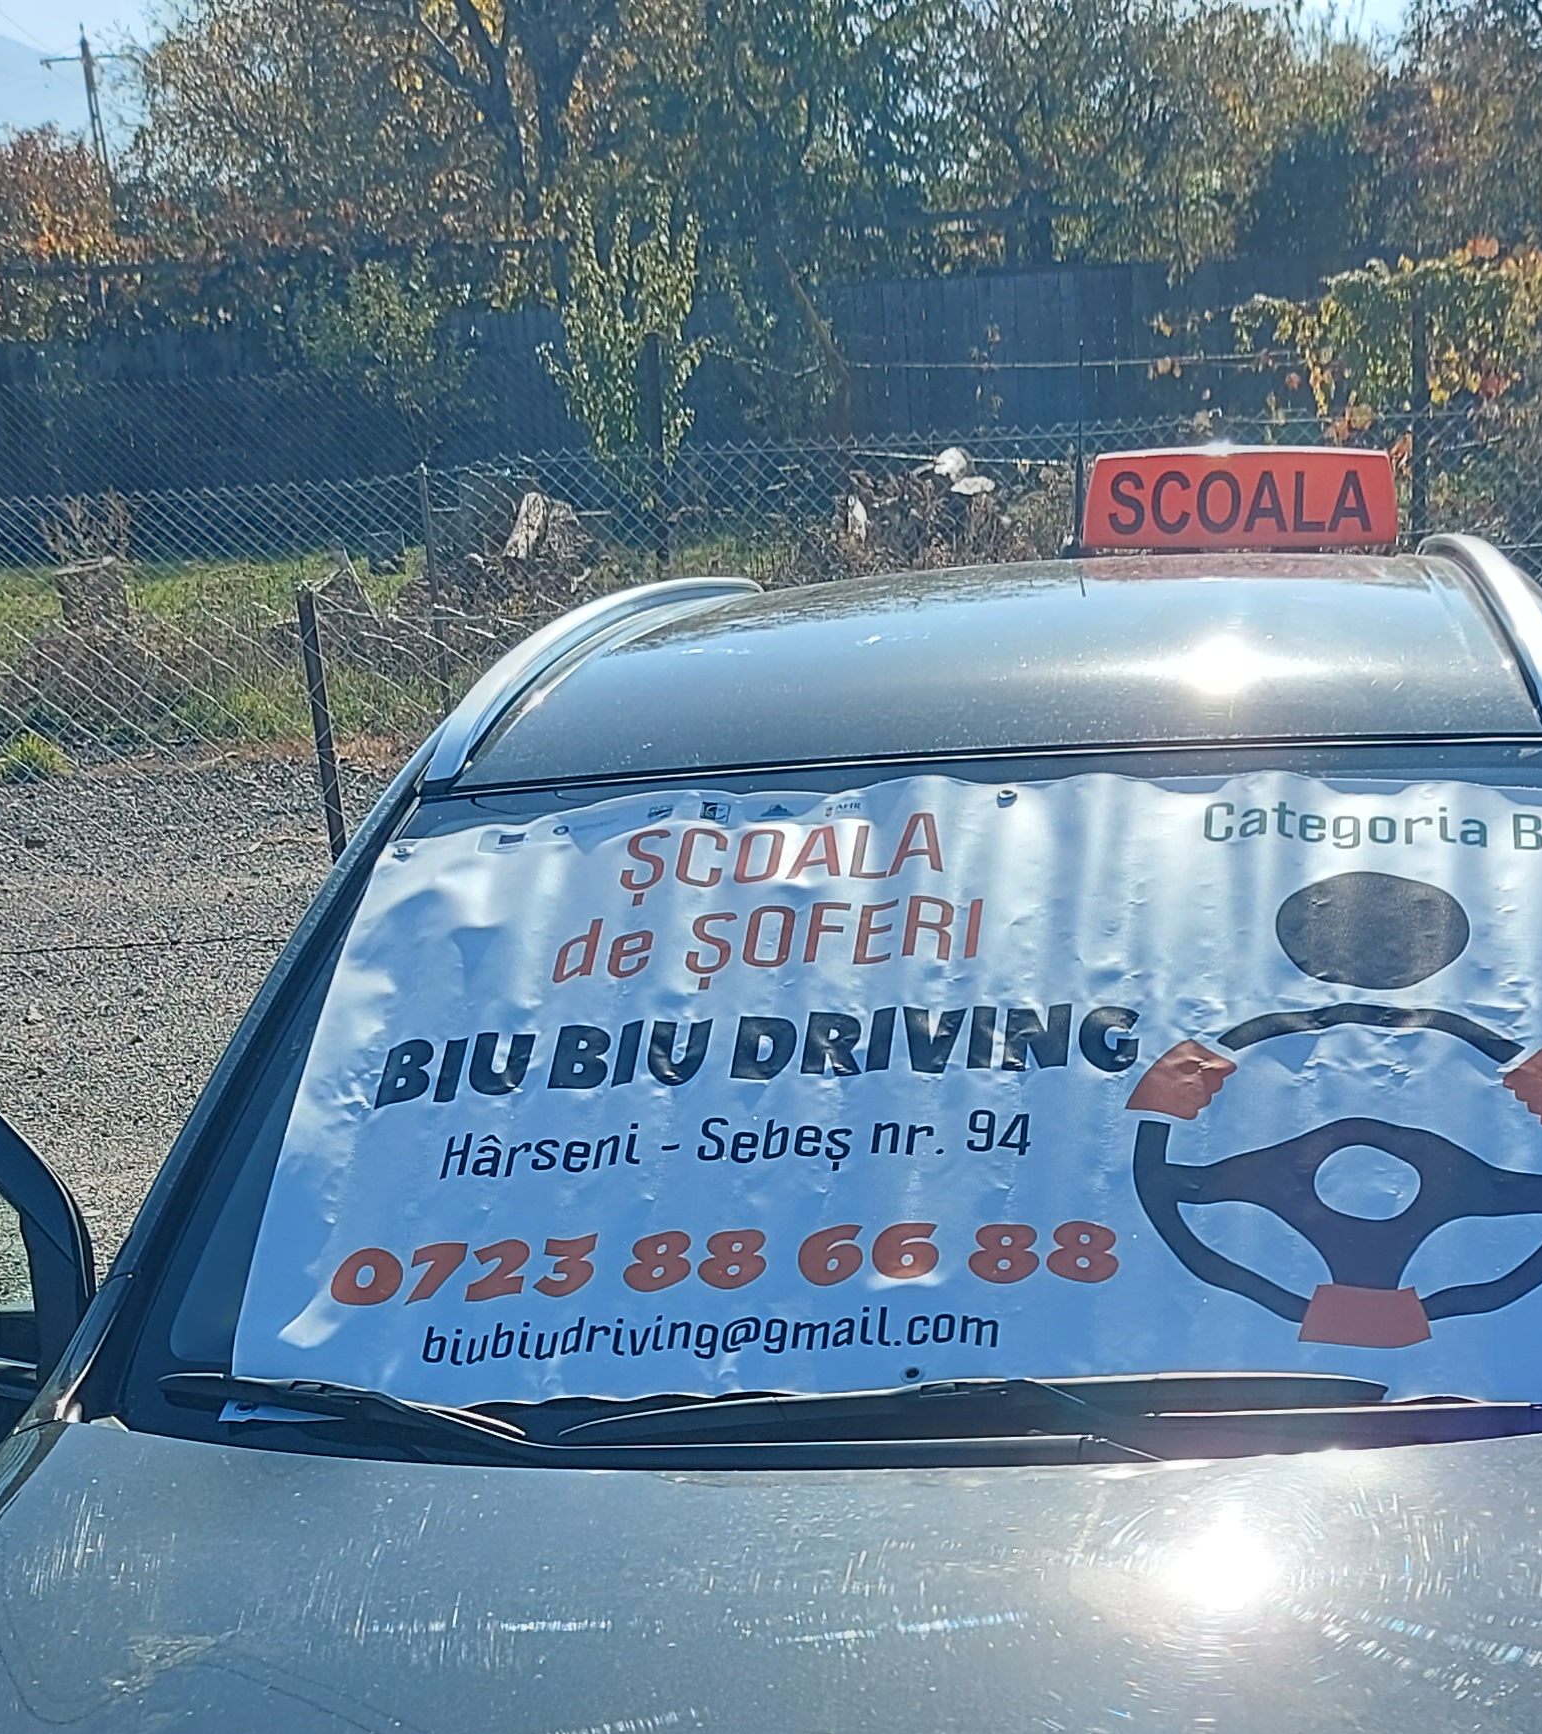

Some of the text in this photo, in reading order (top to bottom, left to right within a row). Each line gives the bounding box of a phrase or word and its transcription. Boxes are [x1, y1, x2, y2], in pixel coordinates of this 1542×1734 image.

[1108, 469, 1372, 536] SCOALA
[619, 811, 944, 907] ȘCOALA
[1203, 800, 1489, 850] Categoria
[551, 894, 984, 991] de ȘOFERI
[373, 1002, 1142, 1109] BIU BIU DRIVING
[438, 1120, 642, 1180] Hârseni
[695, 1116, 854, 1173] Sebeș
[869, 1120, 945, 1157] nr.
[965, 1108, 1032, 1157] 94
[329, 1220, 1121, 1306] 0723 88 66 88
[420, 1306, 1001, 1367] biubiudriving@gmail.com
